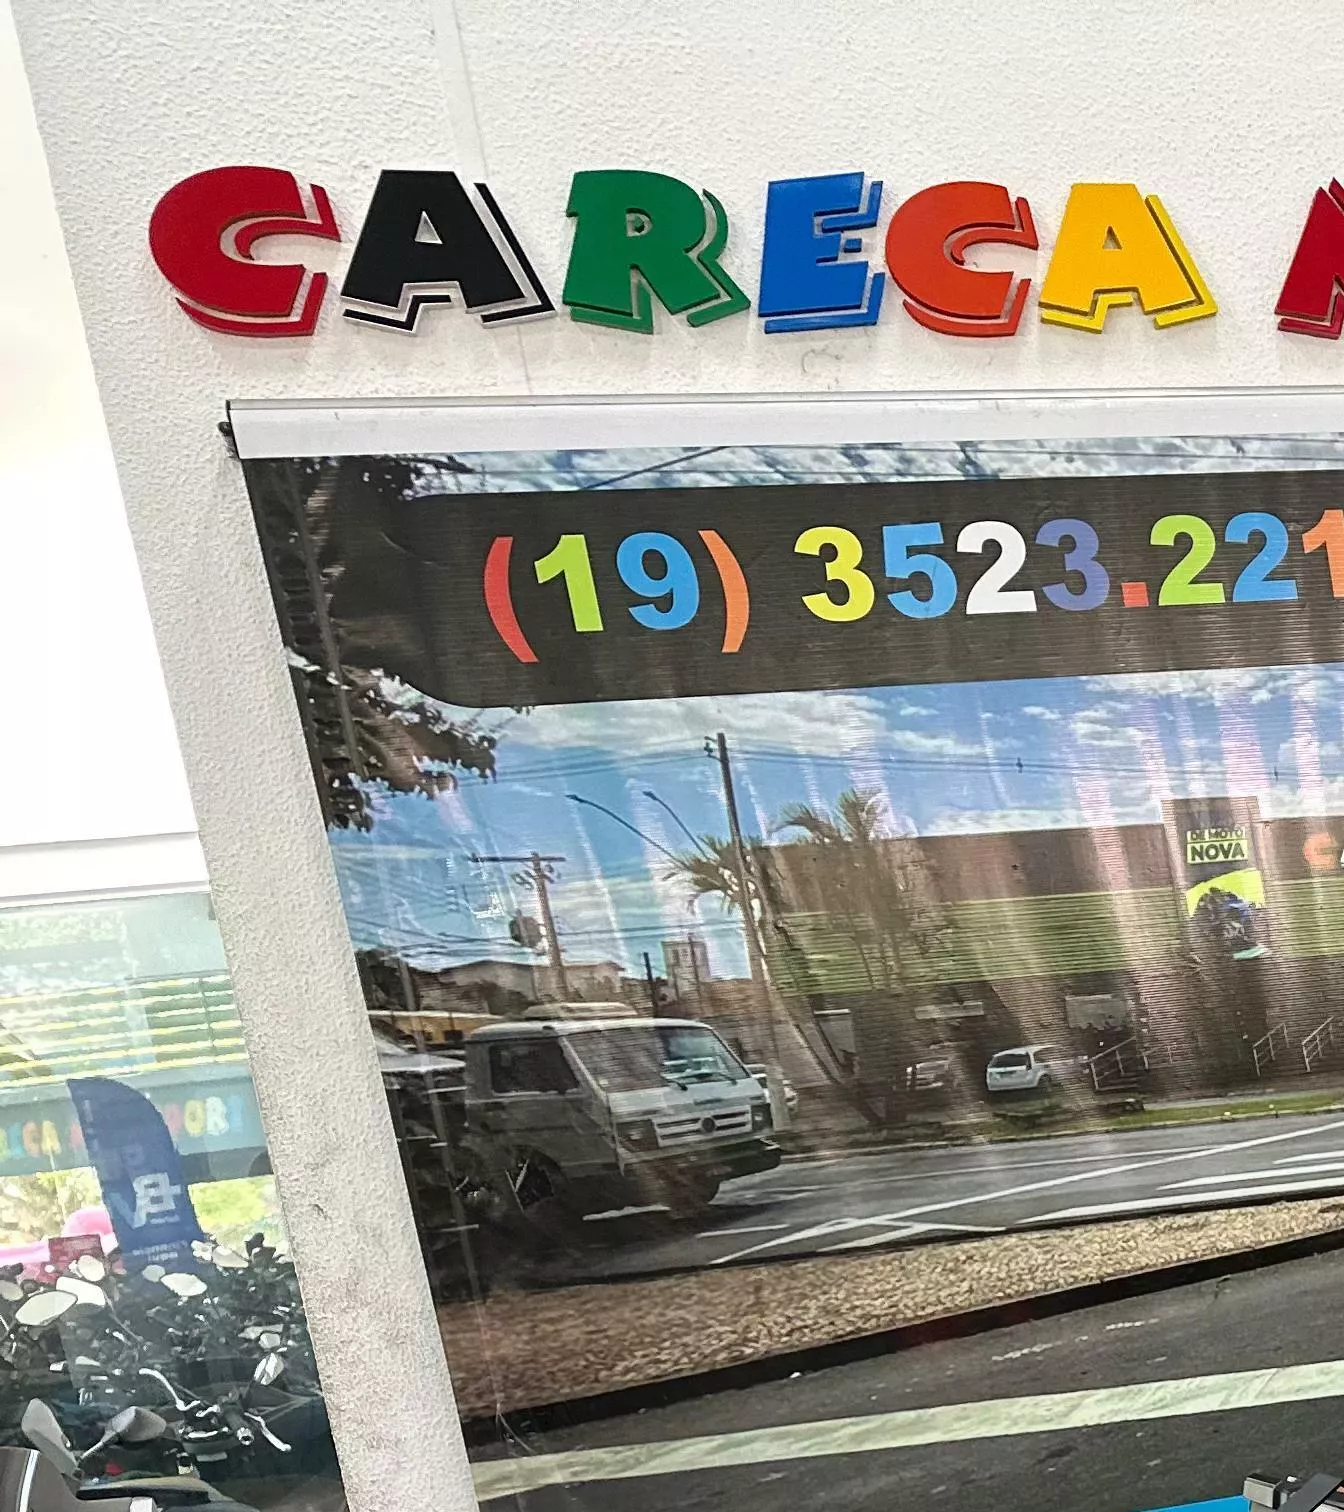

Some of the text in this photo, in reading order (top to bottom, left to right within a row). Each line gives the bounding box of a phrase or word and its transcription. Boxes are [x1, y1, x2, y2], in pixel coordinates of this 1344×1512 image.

[148, 164, 1219, 337] CARECA
[484, 528, 750, 665] (19)
[1190, 842, 1245, 861] NOVA
